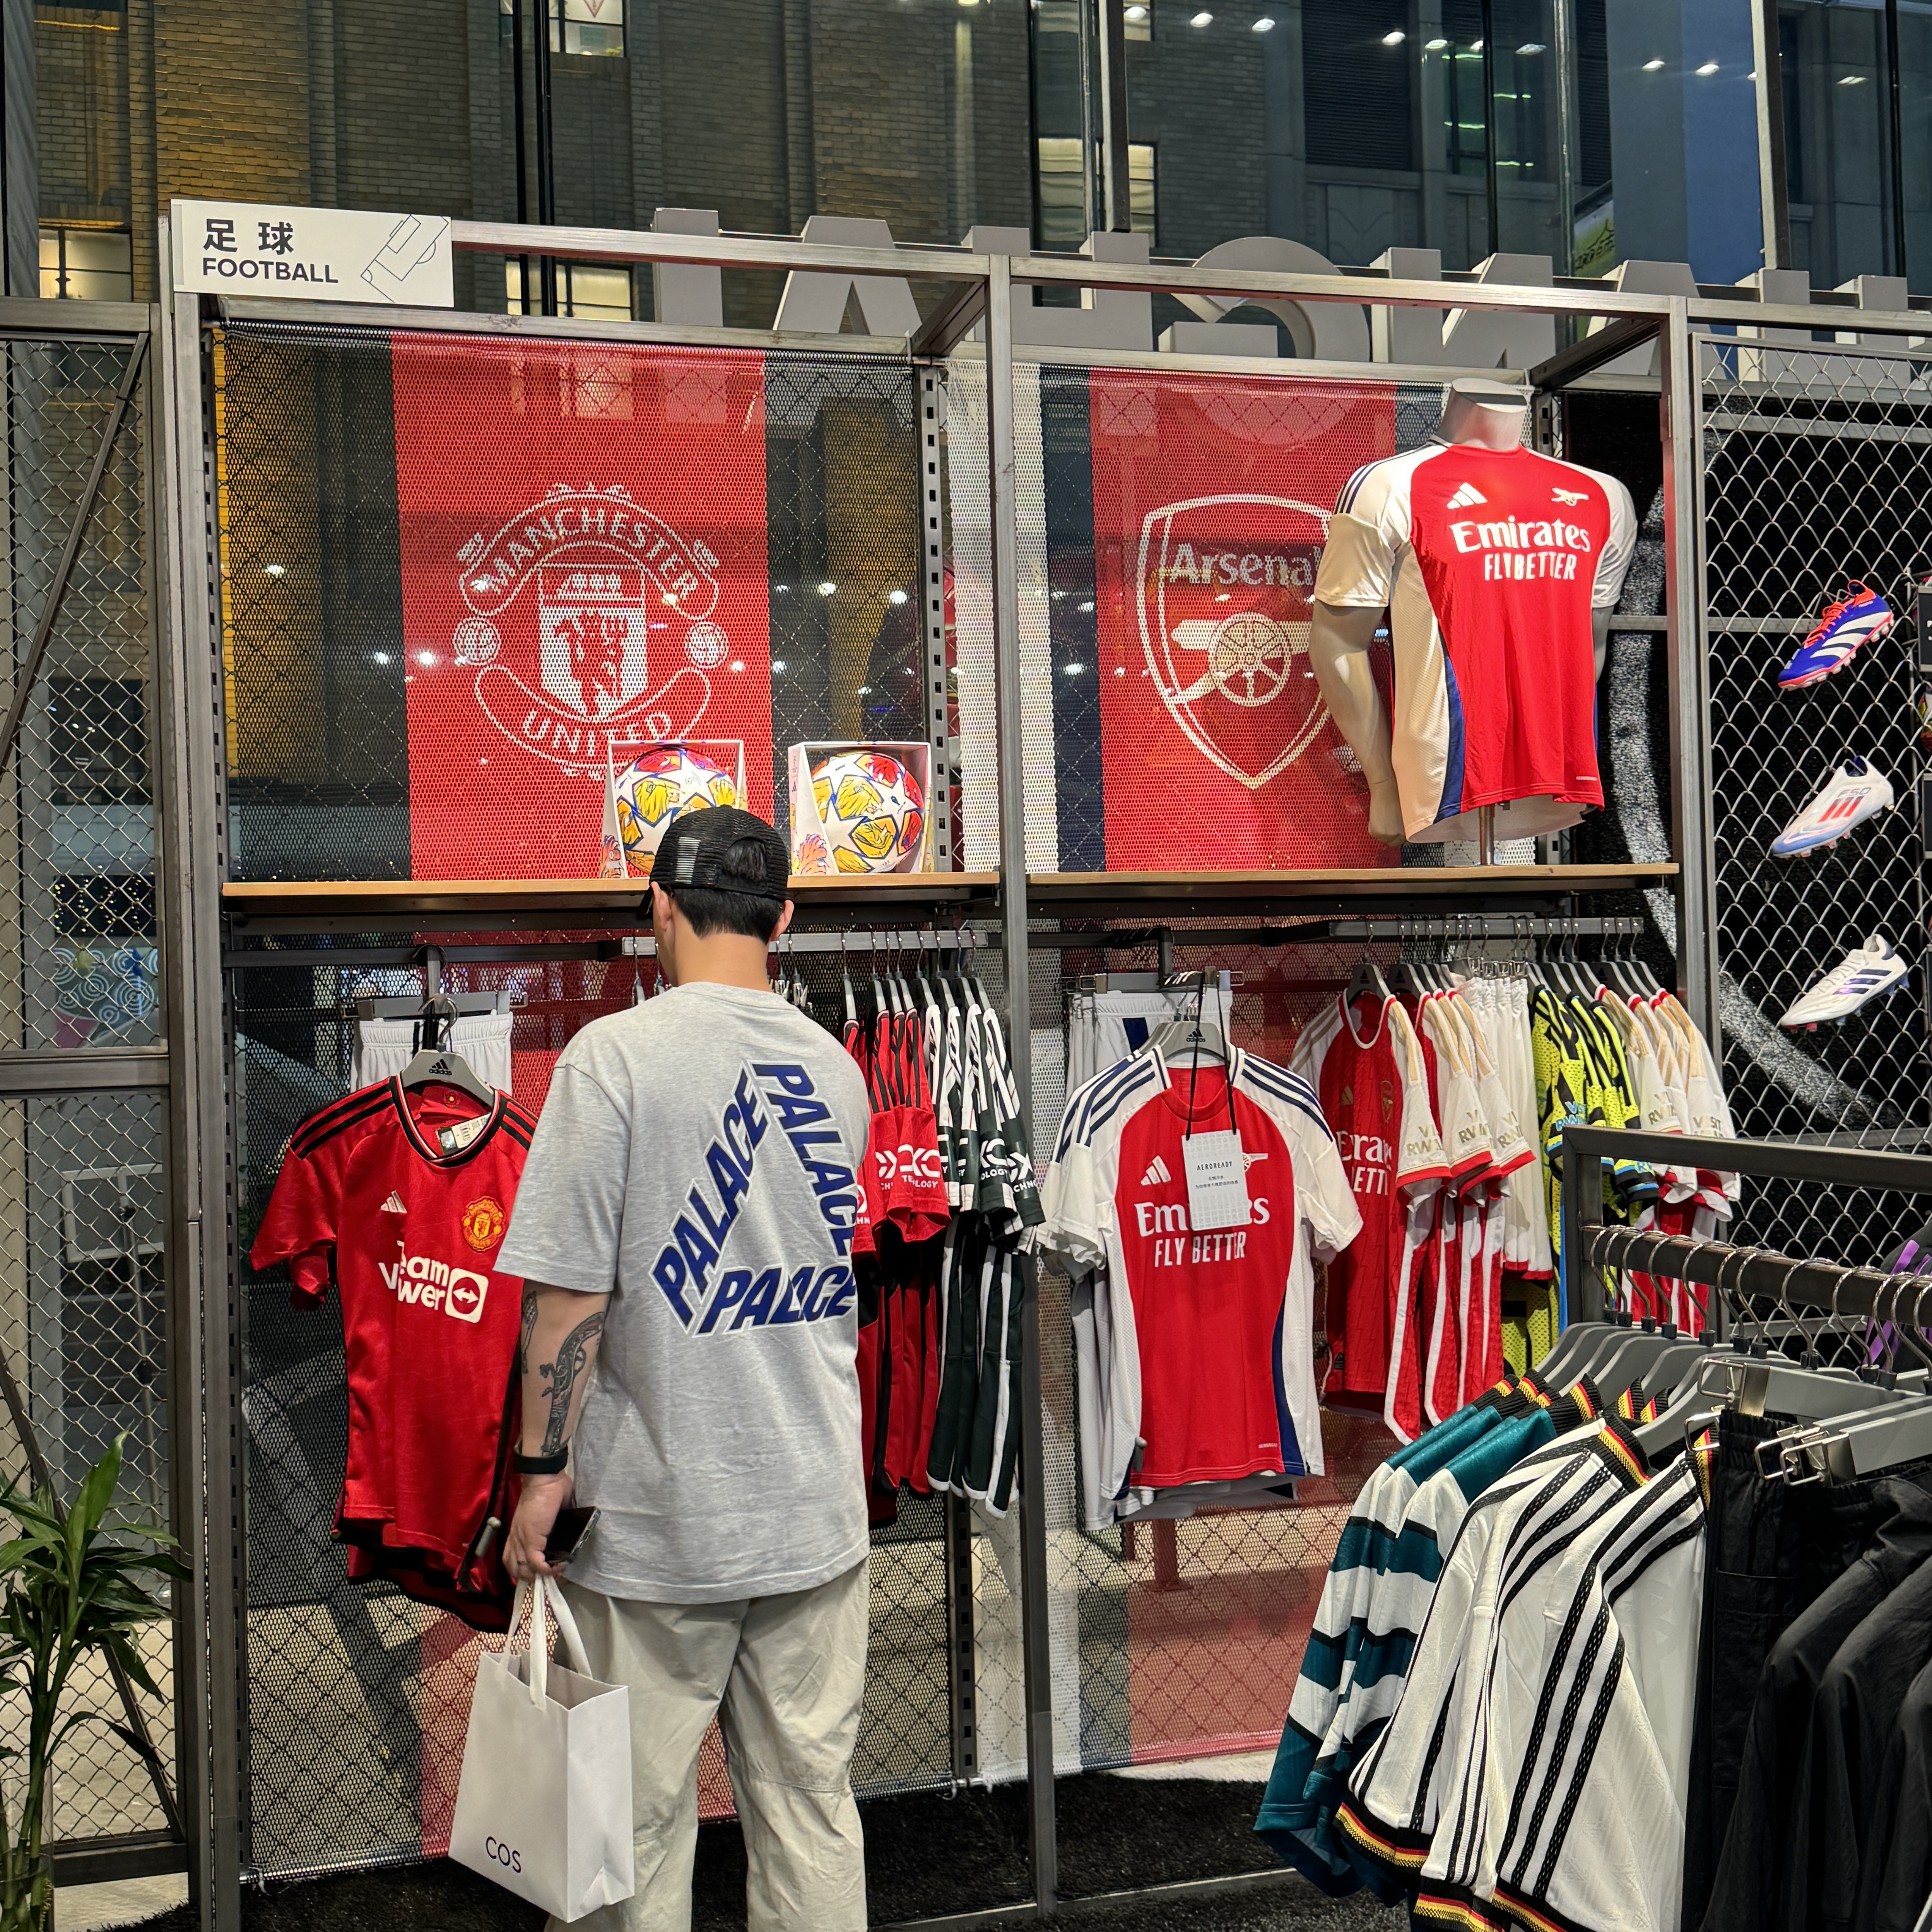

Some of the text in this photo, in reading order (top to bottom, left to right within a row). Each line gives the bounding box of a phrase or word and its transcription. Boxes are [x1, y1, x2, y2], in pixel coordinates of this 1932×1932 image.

[203, 218, 294, 255] 足球
[203, 258, 338, 284] FOOTBALL
[1449, 515, 1591, 553] Emirates
[483, 506, 699, 601] MANCHESTER
[1197, 1161, 1233, 1171] AEROREADY
[650, 1060, 770, 1334] PALACE
[1155, 1237, 1186, 1268] FLY
[486, 1836, 521, 1873] COS
